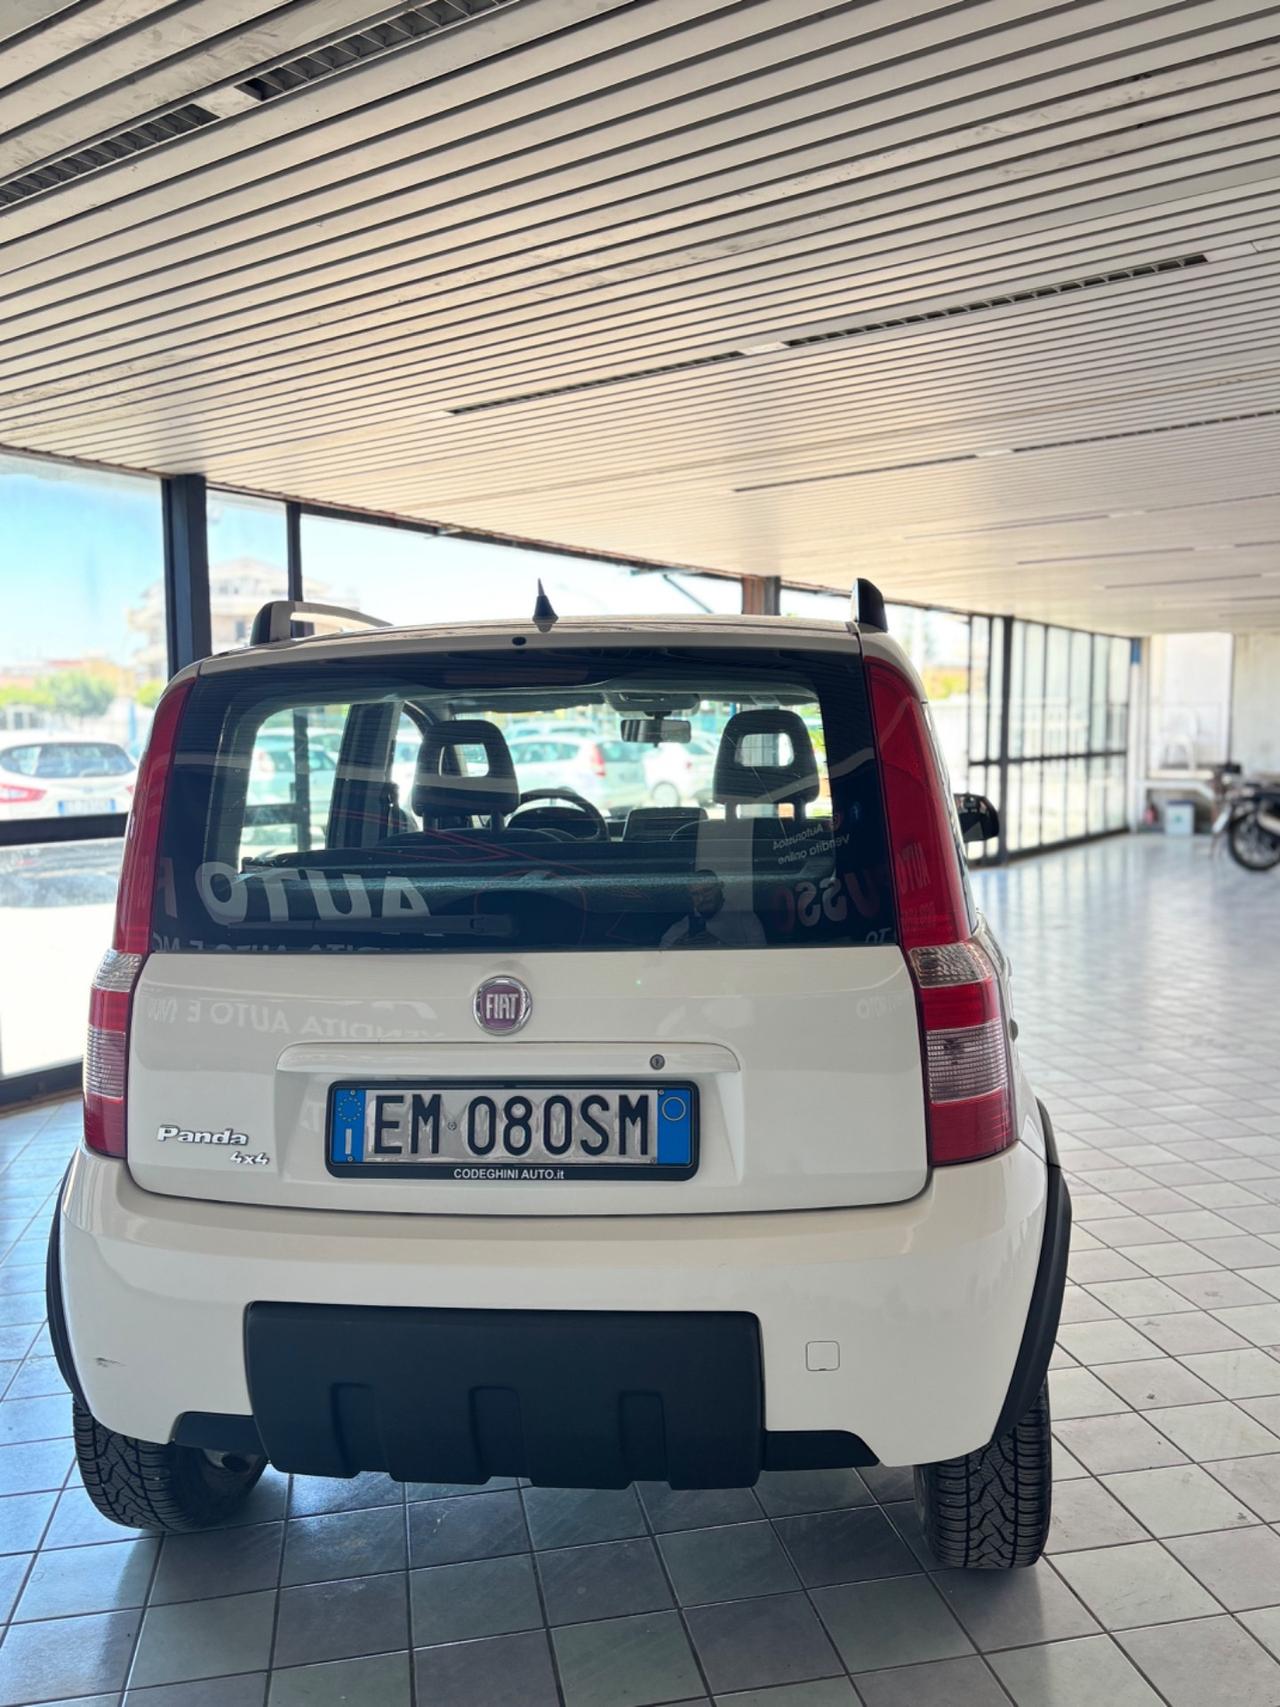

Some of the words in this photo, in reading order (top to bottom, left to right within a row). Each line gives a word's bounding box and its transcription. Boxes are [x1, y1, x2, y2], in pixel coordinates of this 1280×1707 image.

[486, 994, 519, 1019] FIAT
[373, 1093, 443, 1155] EM
[467, 1094, 650, 1156] 080SM
[157, 1125, 249, 1146] Panda
[230, 1151, 270, 1165] 4x4
[453, 1168, 519, 1179] CODEGHINI
[520, 1169, 565, 1180] AUTO.it
